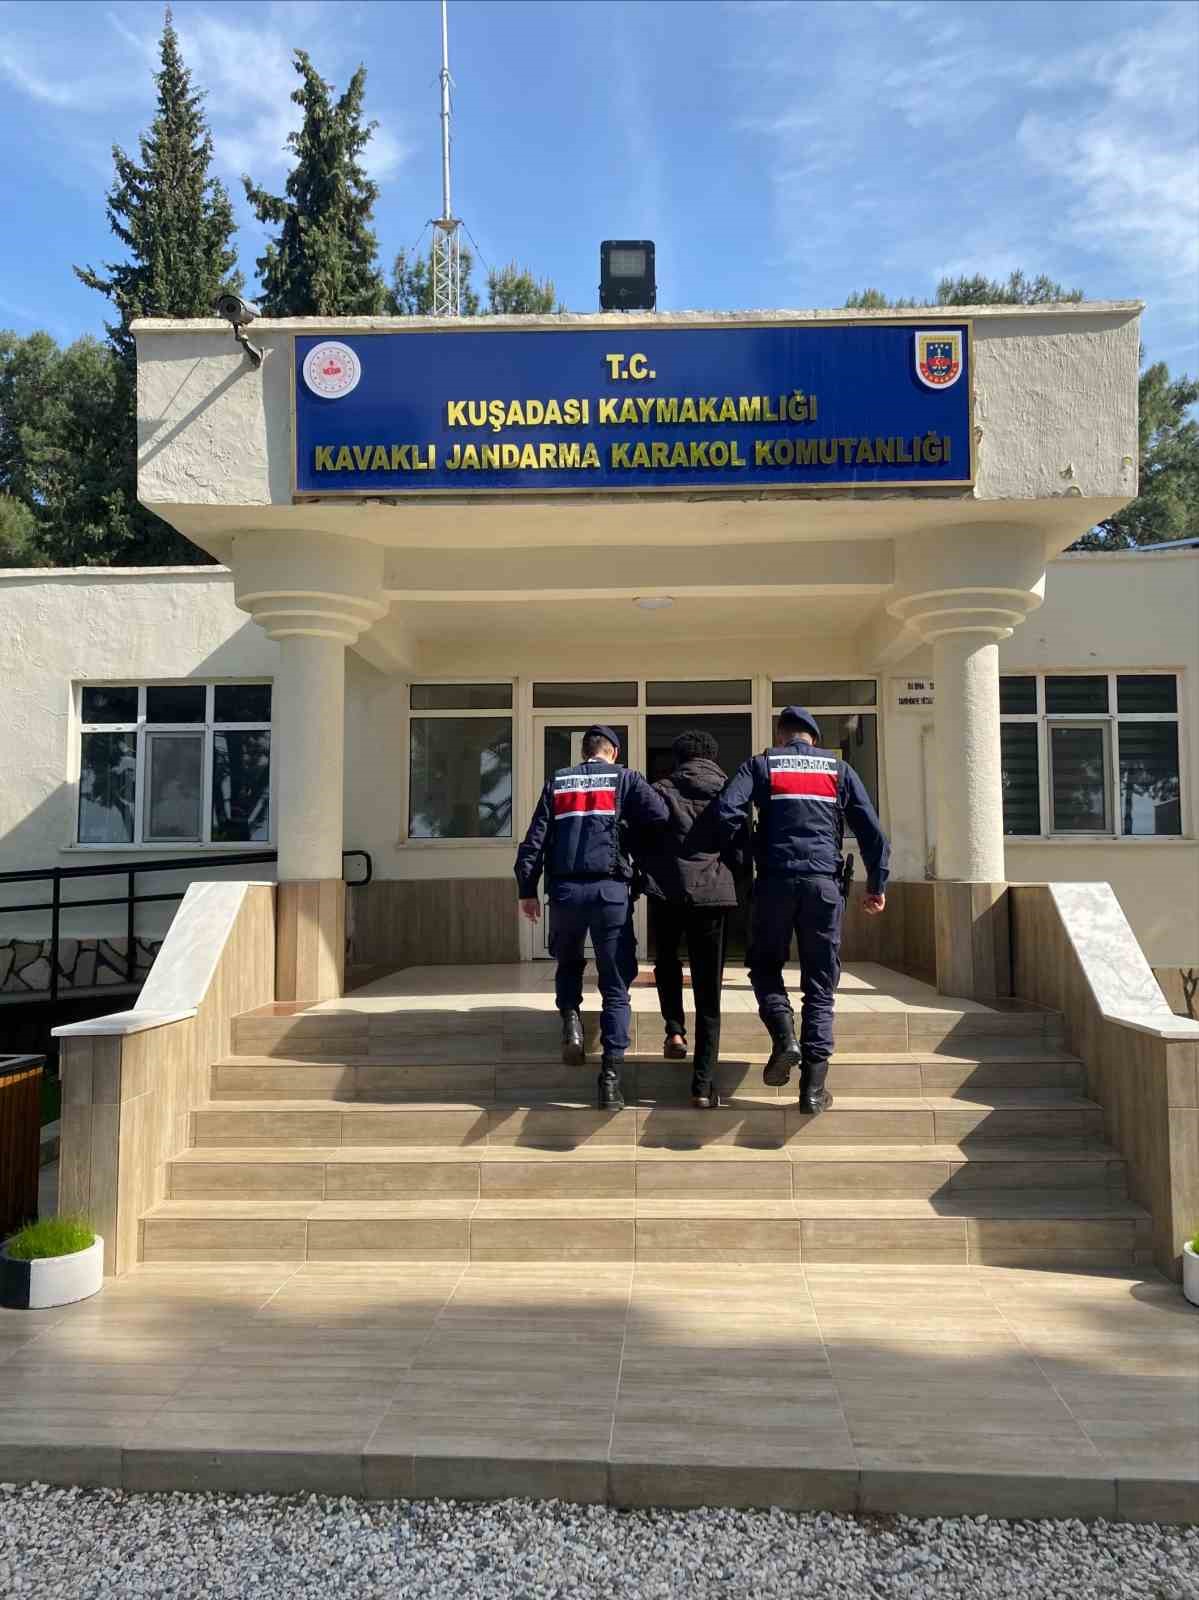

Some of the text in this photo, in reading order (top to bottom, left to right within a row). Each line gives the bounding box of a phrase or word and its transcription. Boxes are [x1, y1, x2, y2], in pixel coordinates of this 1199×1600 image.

[606, 353, 656, 380] T.C.
[447, 389, 817, 432] KUŞADASI KAYMAKAMLIĞI
[314, 432, 951, 471] KAVAKLI JANDARMA KARAKOL KOMUTANLIĞI
[777, 758, 830, 771] JANDARMA
[561, 777, 610, 789] JANDARMA
